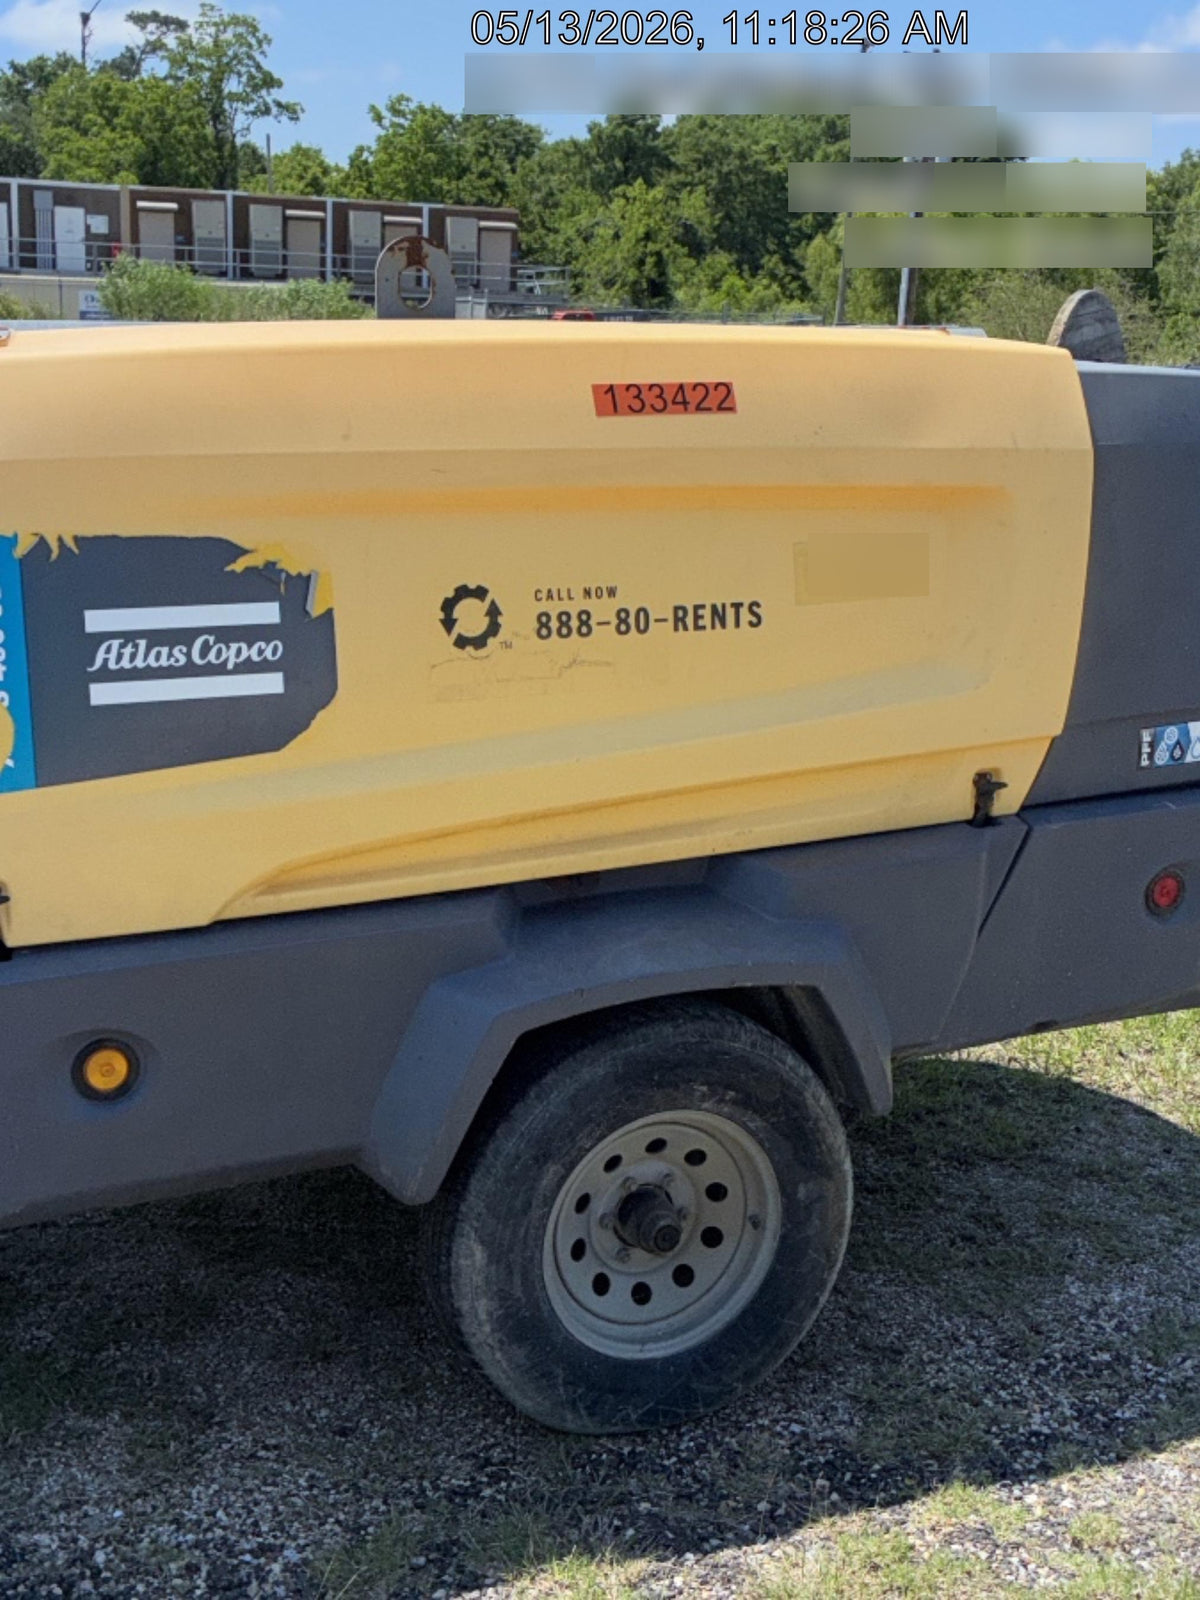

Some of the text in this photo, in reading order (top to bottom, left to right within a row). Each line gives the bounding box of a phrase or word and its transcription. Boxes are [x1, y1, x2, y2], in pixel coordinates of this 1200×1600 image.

[603, 381, 735, 414] 133422
[534, 585, 618, 602] CALL NOW
[535, 600, 763, 641] 888-80-RENTS
[86, 634, 284, 672] Atlas Copco
